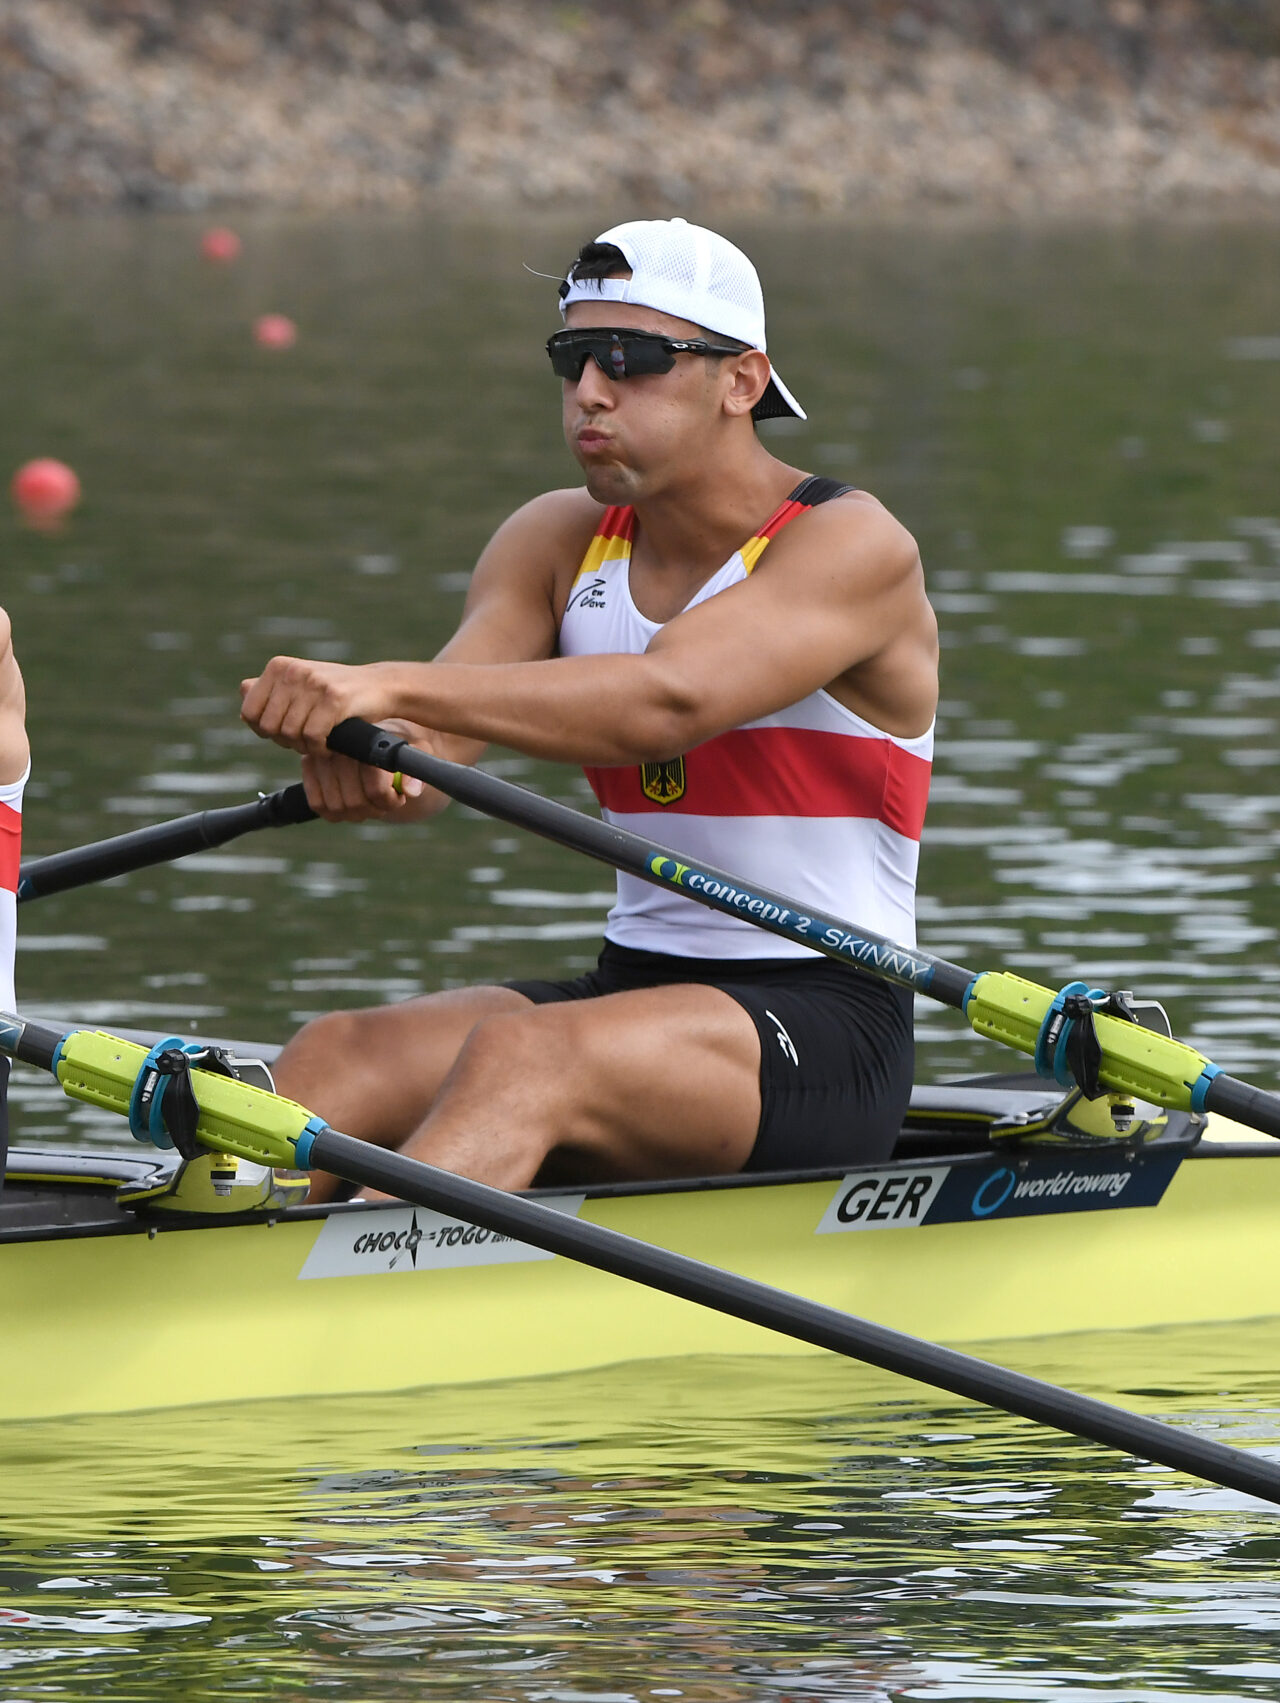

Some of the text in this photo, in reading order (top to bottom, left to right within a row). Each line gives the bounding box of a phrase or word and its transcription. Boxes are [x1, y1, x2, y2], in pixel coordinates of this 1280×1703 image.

[688, 874, 931, 980] concept 2 SKINNY
[836, 1175, 933, 1224] GER
